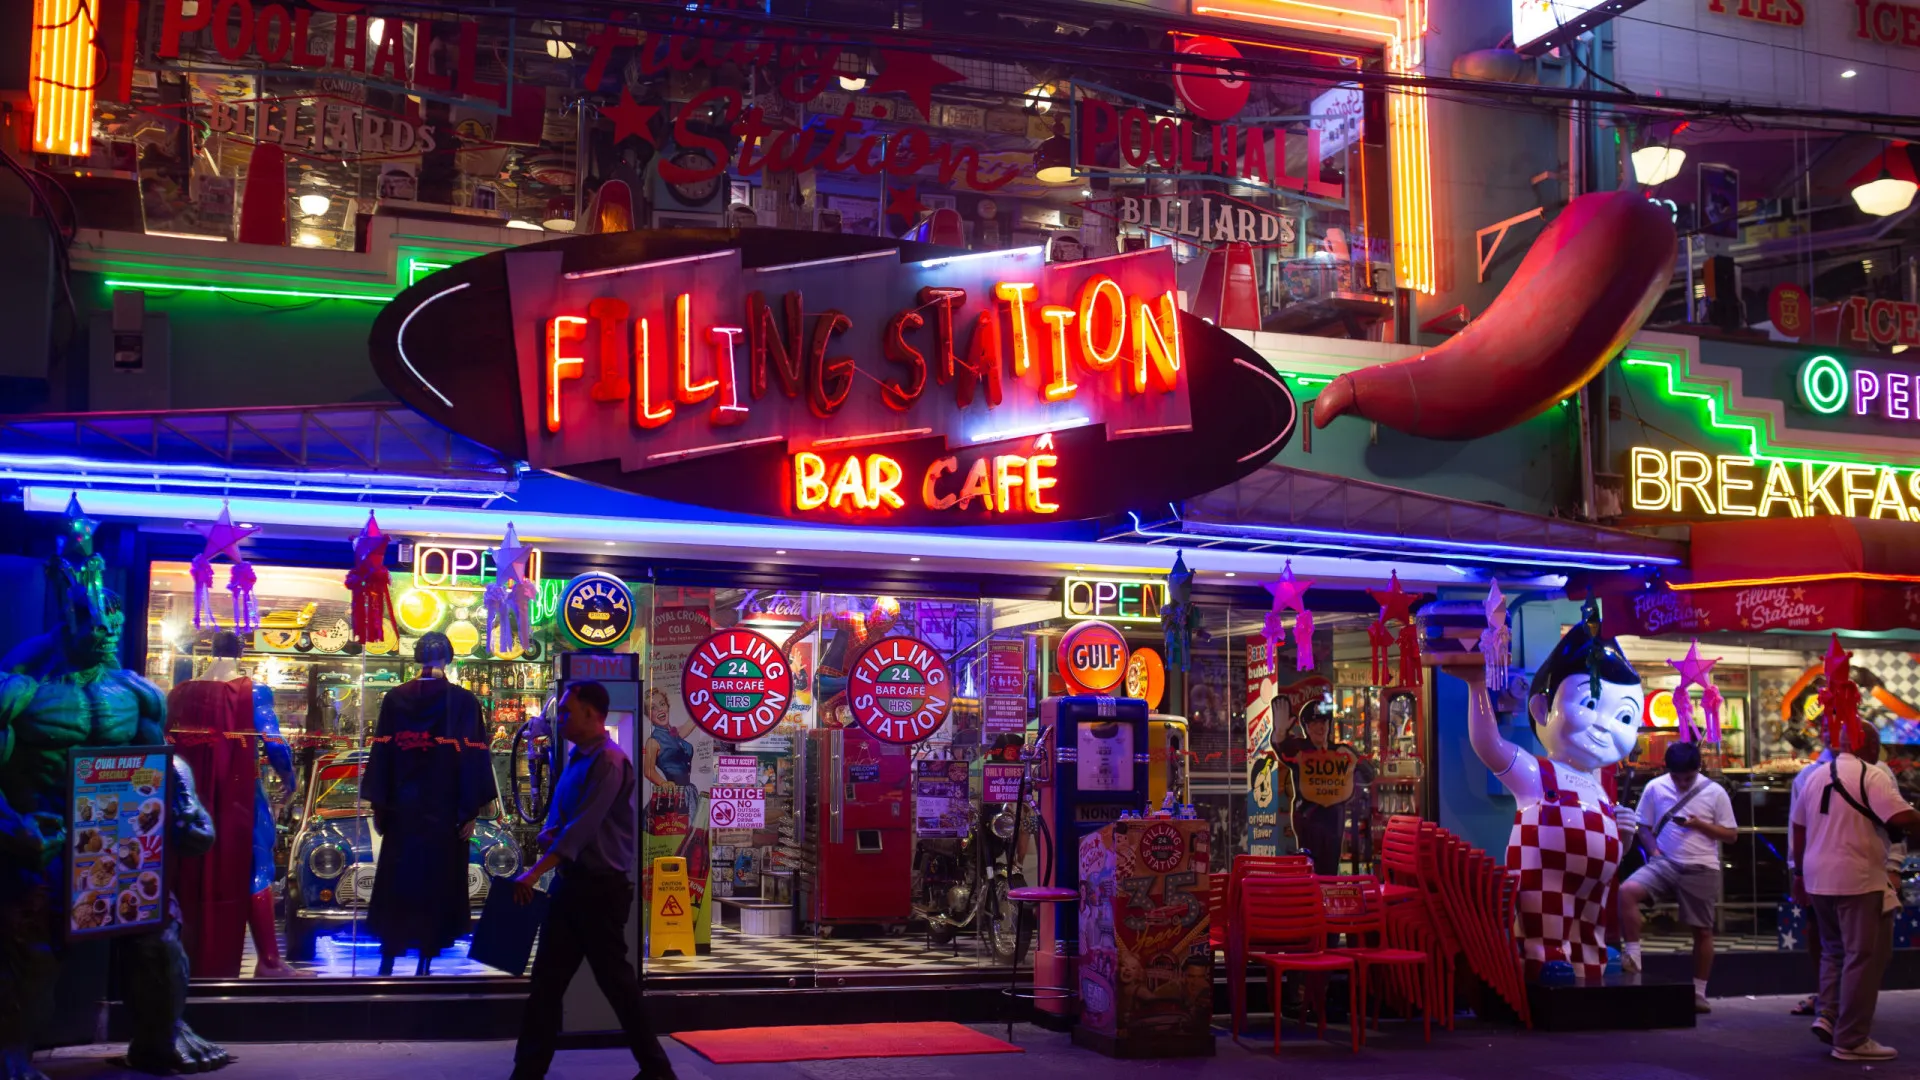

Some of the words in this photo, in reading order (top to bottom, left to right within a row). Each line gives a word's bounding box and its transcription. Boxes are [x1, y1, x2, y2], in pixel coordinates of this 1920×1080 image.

[1854, 0, 1920, 48] ICE
[159, 0, 506, 99] POOLHALL
[210, 102, 436, 153] BILLIARDS
[658, 87, 1018, 190] Station
[1079, 98, 1343, 199] POOLHALL
[1123, 197, 1297, 243] BILLIARDS
[1850, 296, 1920, 347] ICE
[546, 290, 852, 432] FILLING
[883, 274, 1182, 412] STATION
[1803, 355, 1920, 419] OPE
[794, 451, 904, 512] BAR
[571, 583, 627, 610] POLLY
[1070, 581, 1164, 618] OPEN
[1634, 591, 1678, 619] Filling
[1736, 587, 1791, 616] Filling
[668, 624, 691, 633] COLA
[677, 610, 707, 625] CROWN
[1648, 607, 1711, 632] Station
[1751, 602, 1826, 629] Station
[580, 624, 617, 639] GAS
[572, 659, 629, 676] ETHYL
[690, 634, 785, 680] FILLING
[728, 662, 748, 676] 24
[855, 641, 946, 686] FILLING
[1073, 644, 1120, 671] GULF
[711, 680, 734, 691] BAR
[736, 678, 765, 691] CAFÉ
[891, 668, 911, 681] 24
[725, 695, 750, 709] HRS
[875, 685, 896, 696] BAR
[898, 683, 926, 696] CAFÉ
[690, 689, 786, 736] STATION
[855, 694, 947, 740] STATION
[889, 700, 913, 713] HRS
[95, 759, 116, 769] OVAL
[118, 758, 141, 768] PLATE
[1305, 761, 1350, 776] SLOW
[712, 789, 763, 799] NOTICE
[1309, 777, 1345, 787] SCHOOL
[1316, 788, 1339, 796] ZONE
[1249, 812, 1277, 827] original
[1143, 826, 1182, 846] FILLING
[1253, 828, 1273, 841] flavor
[1142, 849, 1182, 870] STATION
[1123, 871, 1199, 930] 35
